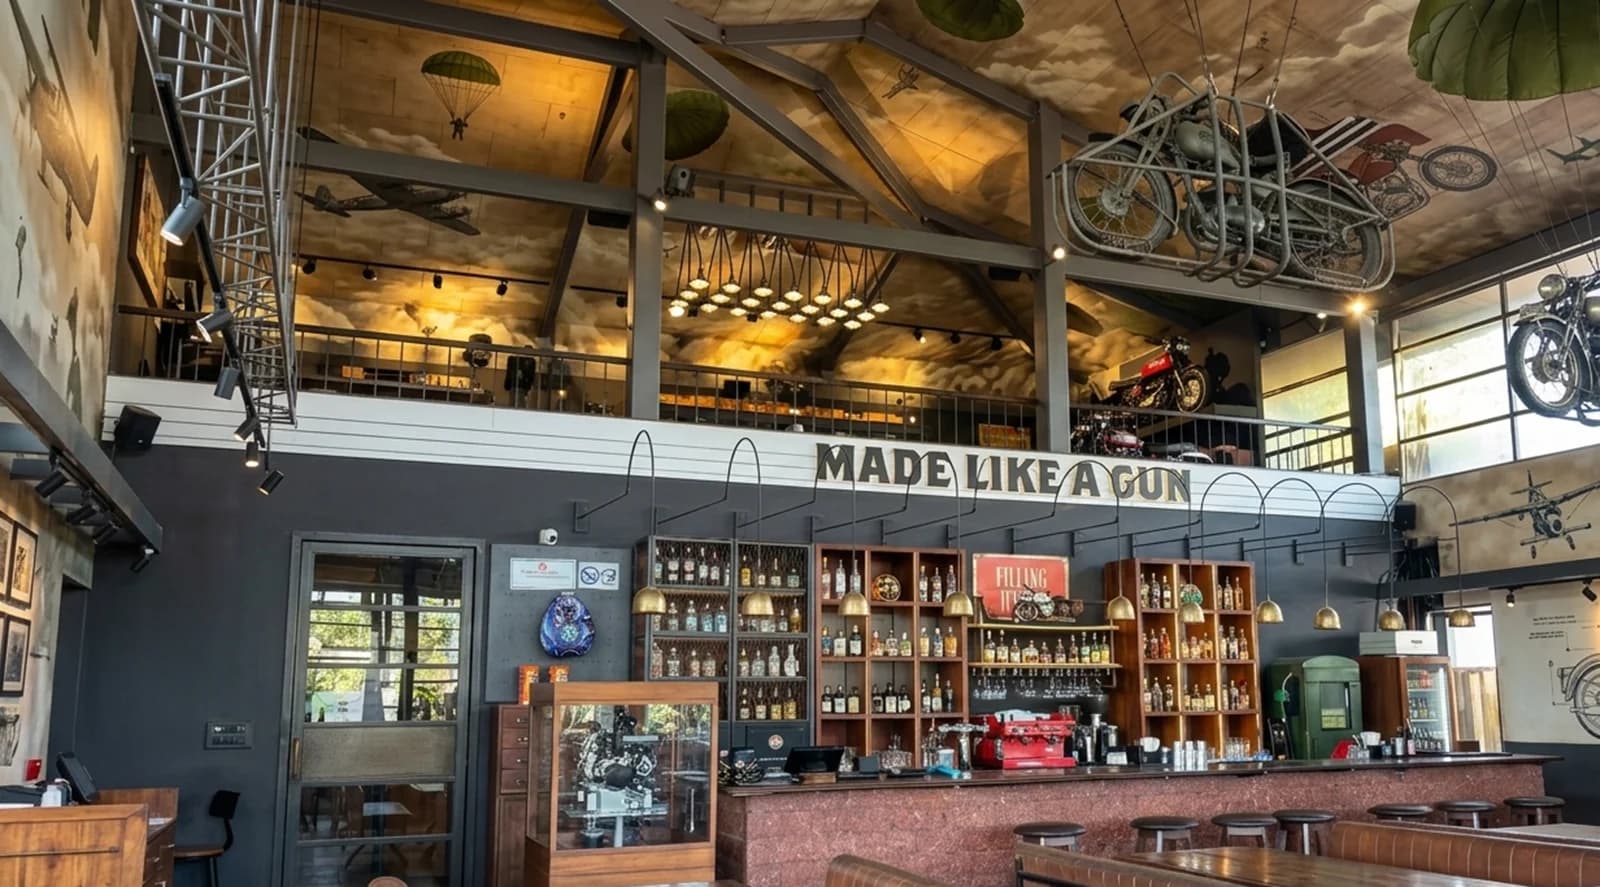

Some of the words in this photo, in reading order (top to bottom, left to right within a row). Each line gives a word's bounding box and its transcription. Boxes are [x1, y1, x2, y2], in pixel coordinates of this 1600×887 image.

[816, 443, 952, 487] MADE
[966, 454, 1060, 494] LIKE
[1071, 463, 1101, 498] A
[1111, 465, 1191, 502] GUN
[996, 566, 1047, 588] FILLING
